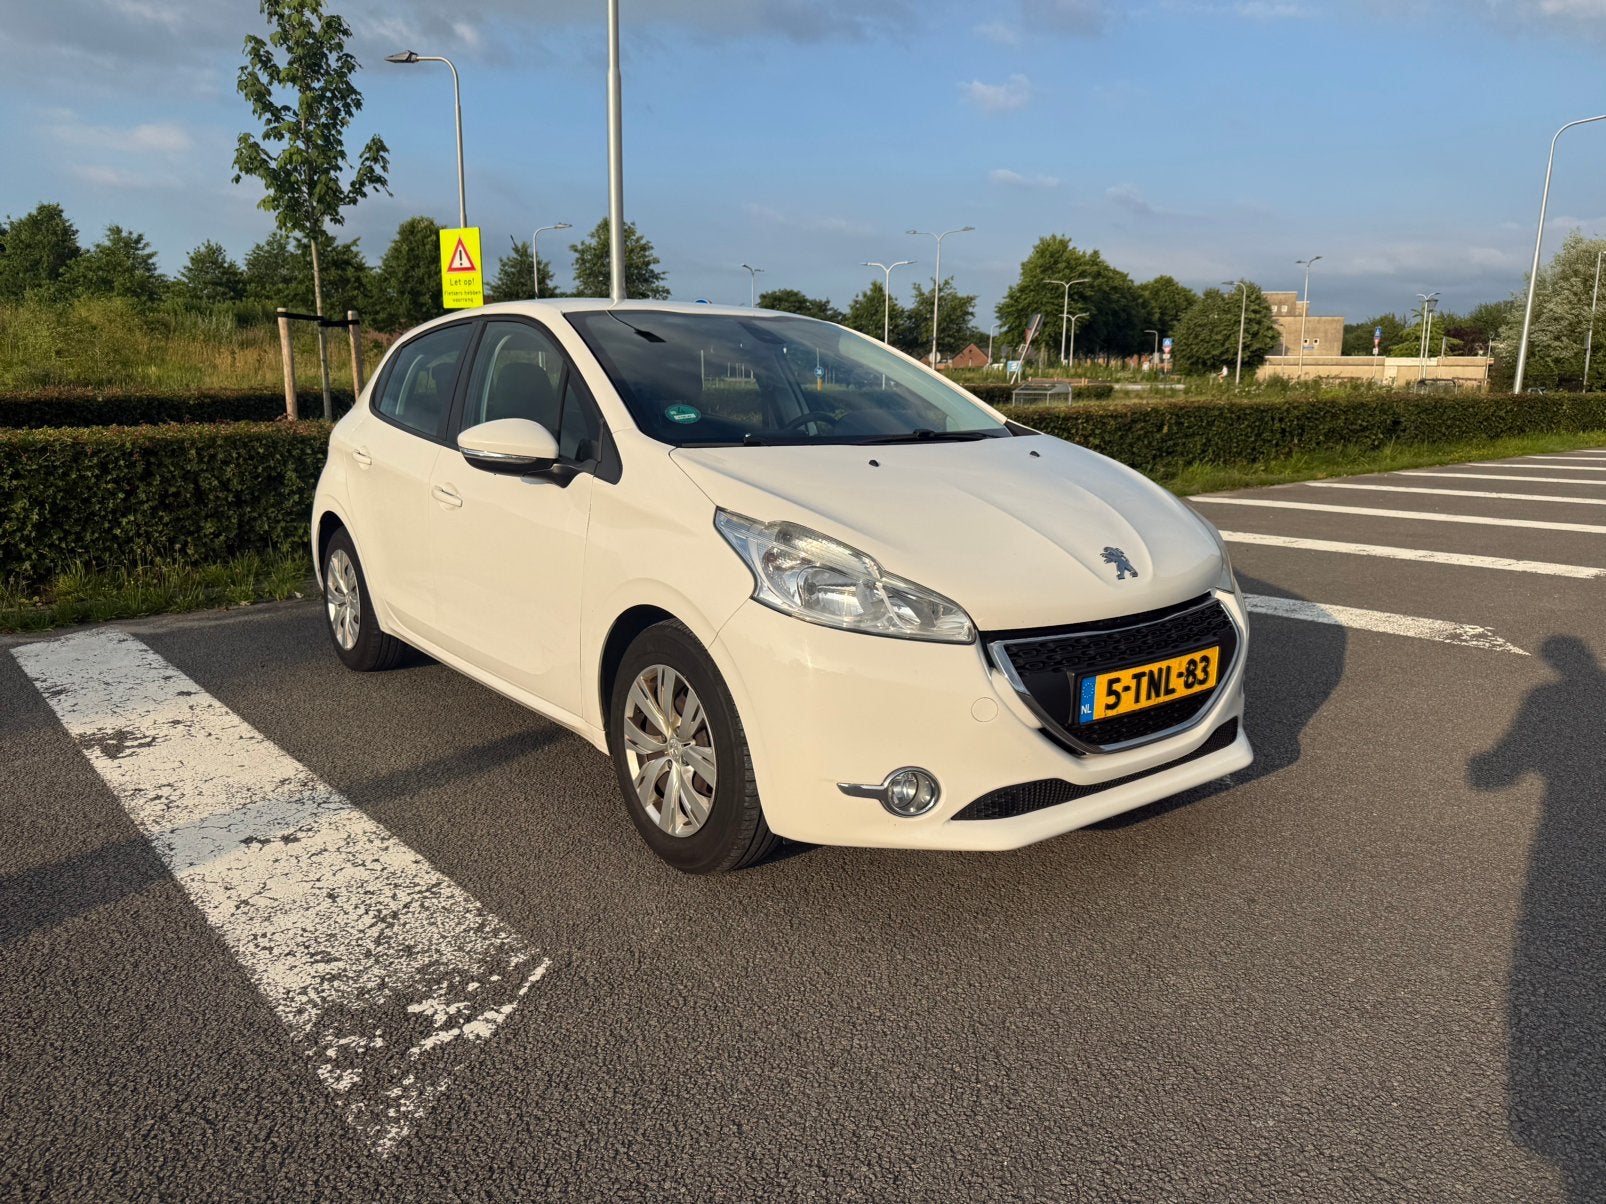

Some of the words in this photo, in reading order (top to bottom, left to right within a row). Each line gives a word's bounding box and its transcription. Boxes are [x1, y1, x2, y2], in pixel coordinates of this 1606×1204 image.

[449, 278, 461, 286] Let
[464, 278, 474, 286] op!
[1105, 655, 1210, 710] 5-TNL-83
[1081, 704, 1092, 715] NL
